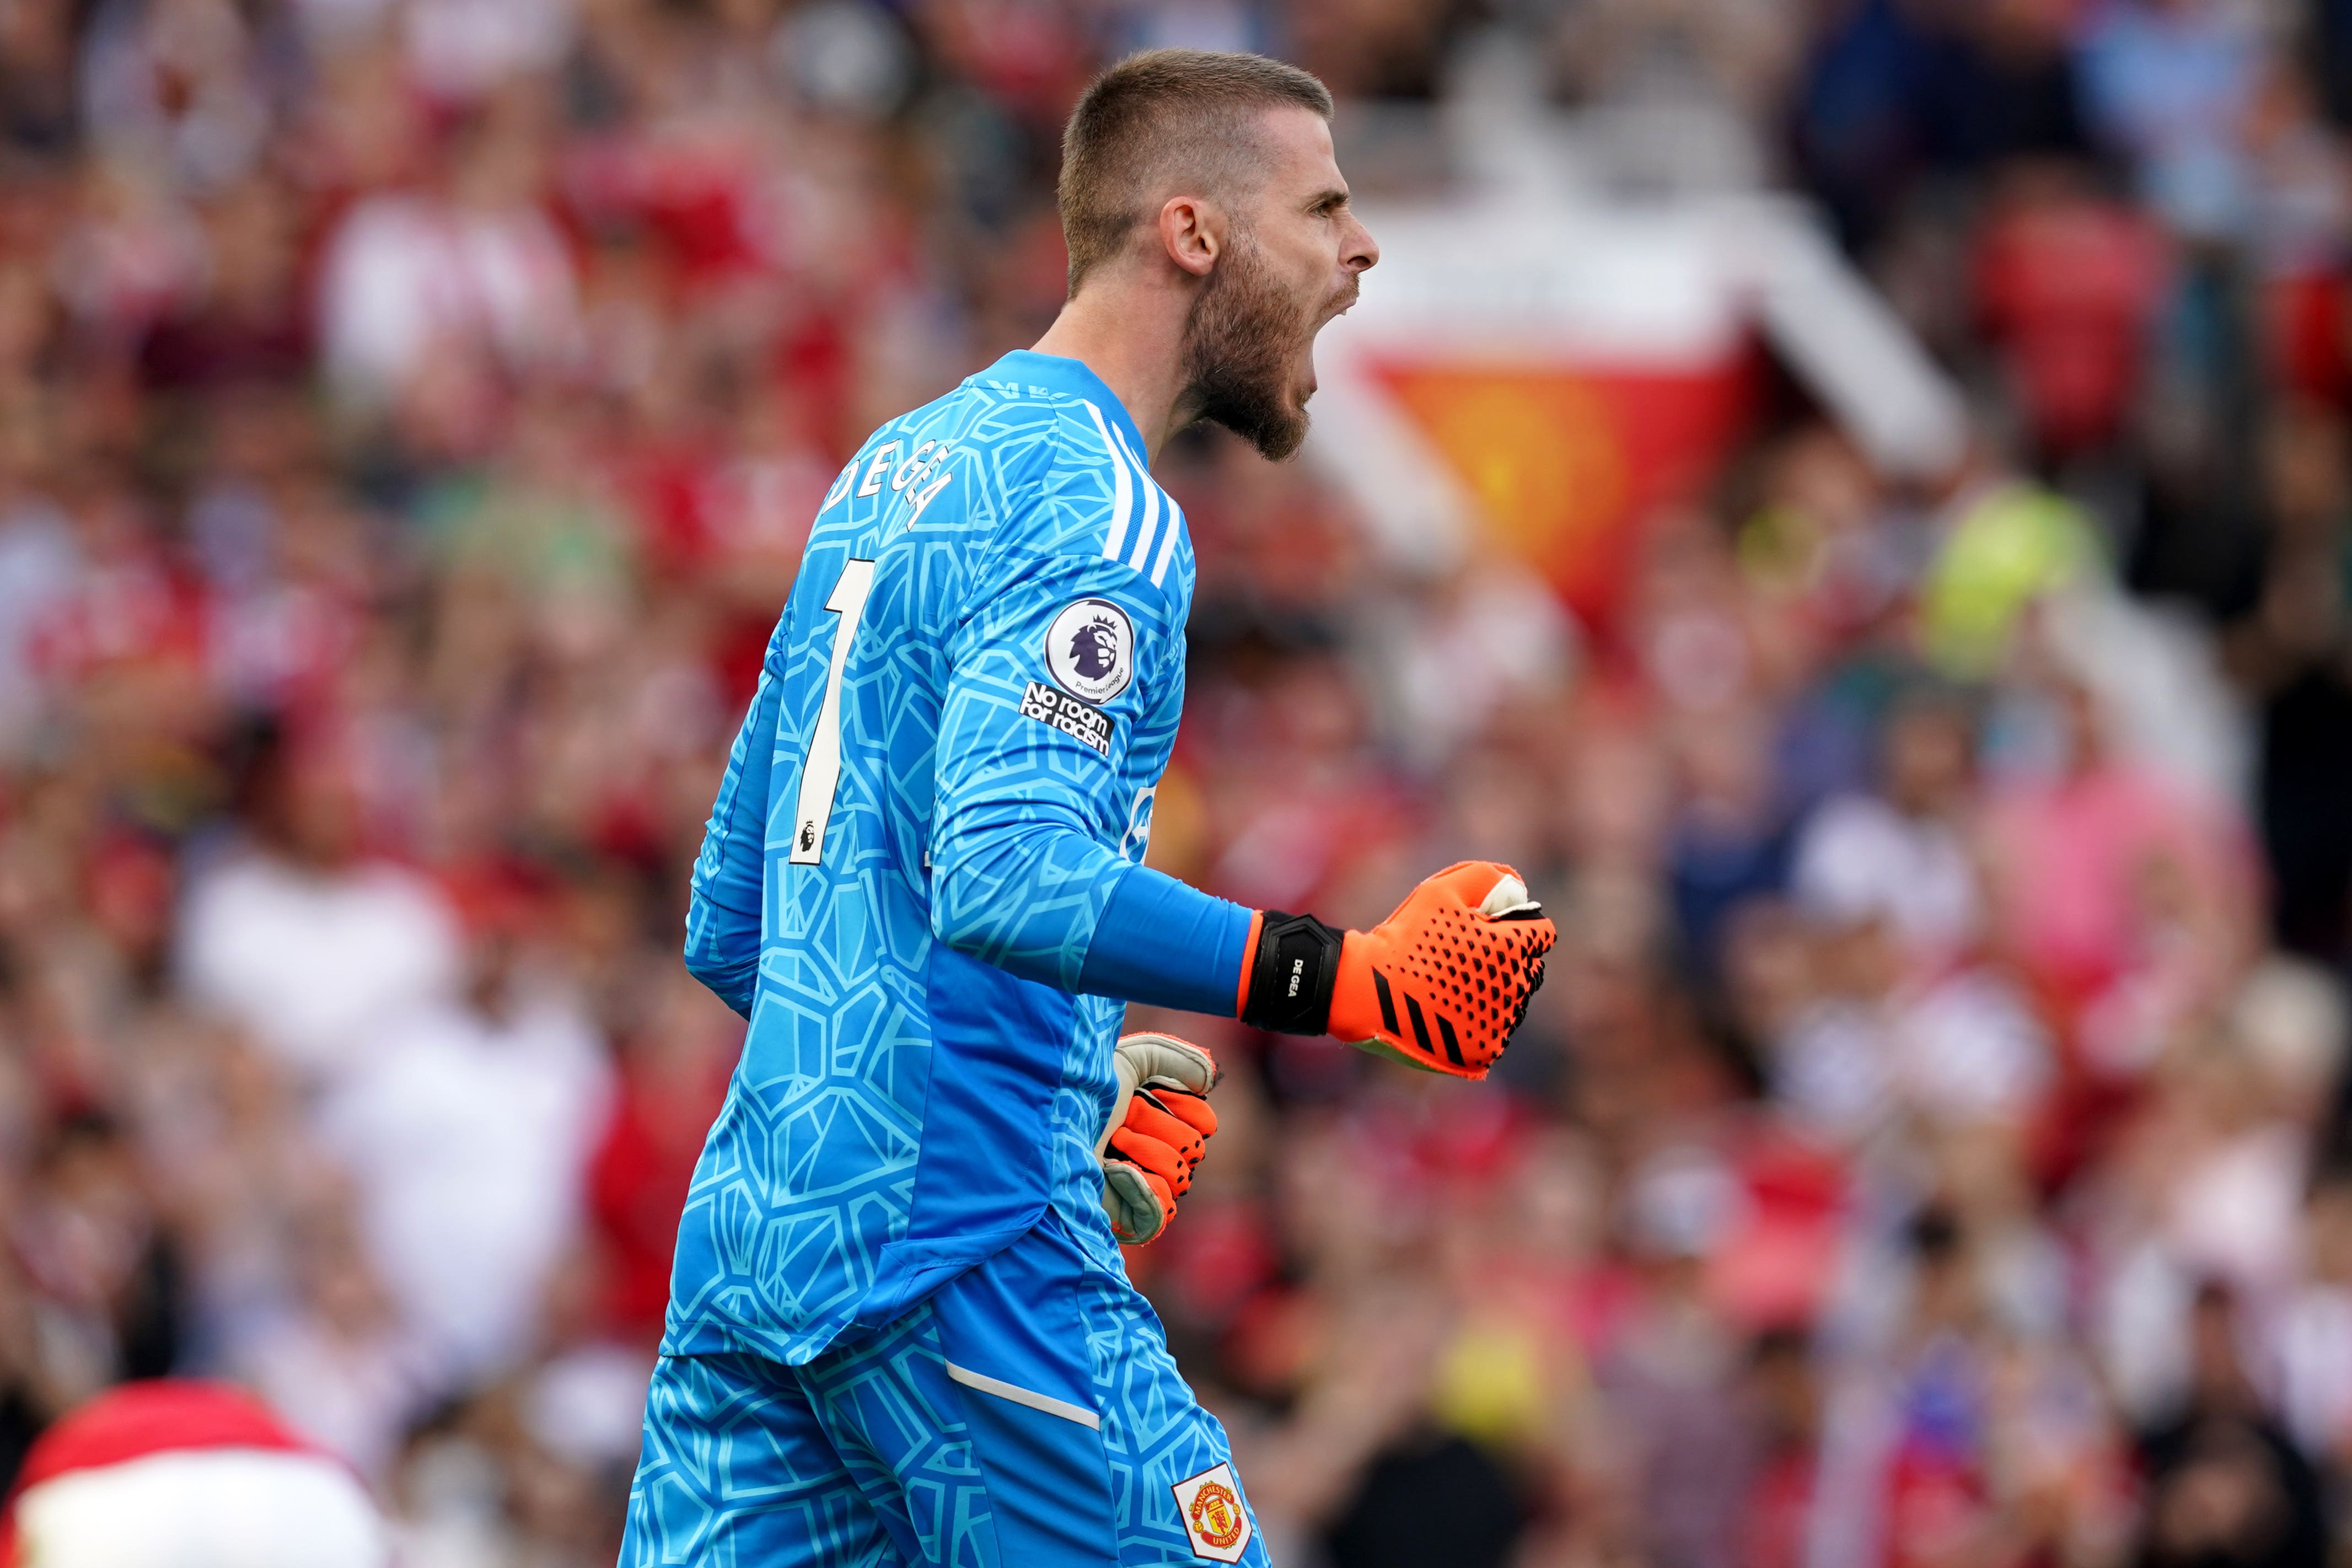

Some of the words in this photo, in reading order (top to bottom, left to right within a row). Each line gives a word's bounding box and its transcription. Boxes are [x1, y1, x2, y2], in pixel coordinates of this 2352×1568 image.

[821, 438, 900, 516] DE
[891, 439, 953, 533] GEA
[1076, 681, 1105, 694] Premier
[1106, 667, 1124, 691] League
[789, 557, 875, 866] 1
[1024, 681, 1057, 708] No
[1058, 697, 1107, 736] room
[1019, 697, 1053, 722] for
[1053, 711, 1109, 757] racism
[1292, 959, 1303, 975] DE
[1287, 975, 1300, 997] GEA
[1194, 1486, 1232, 1516] MANCHESTER
[1212, 1527, 1239, 1545] UNITED
